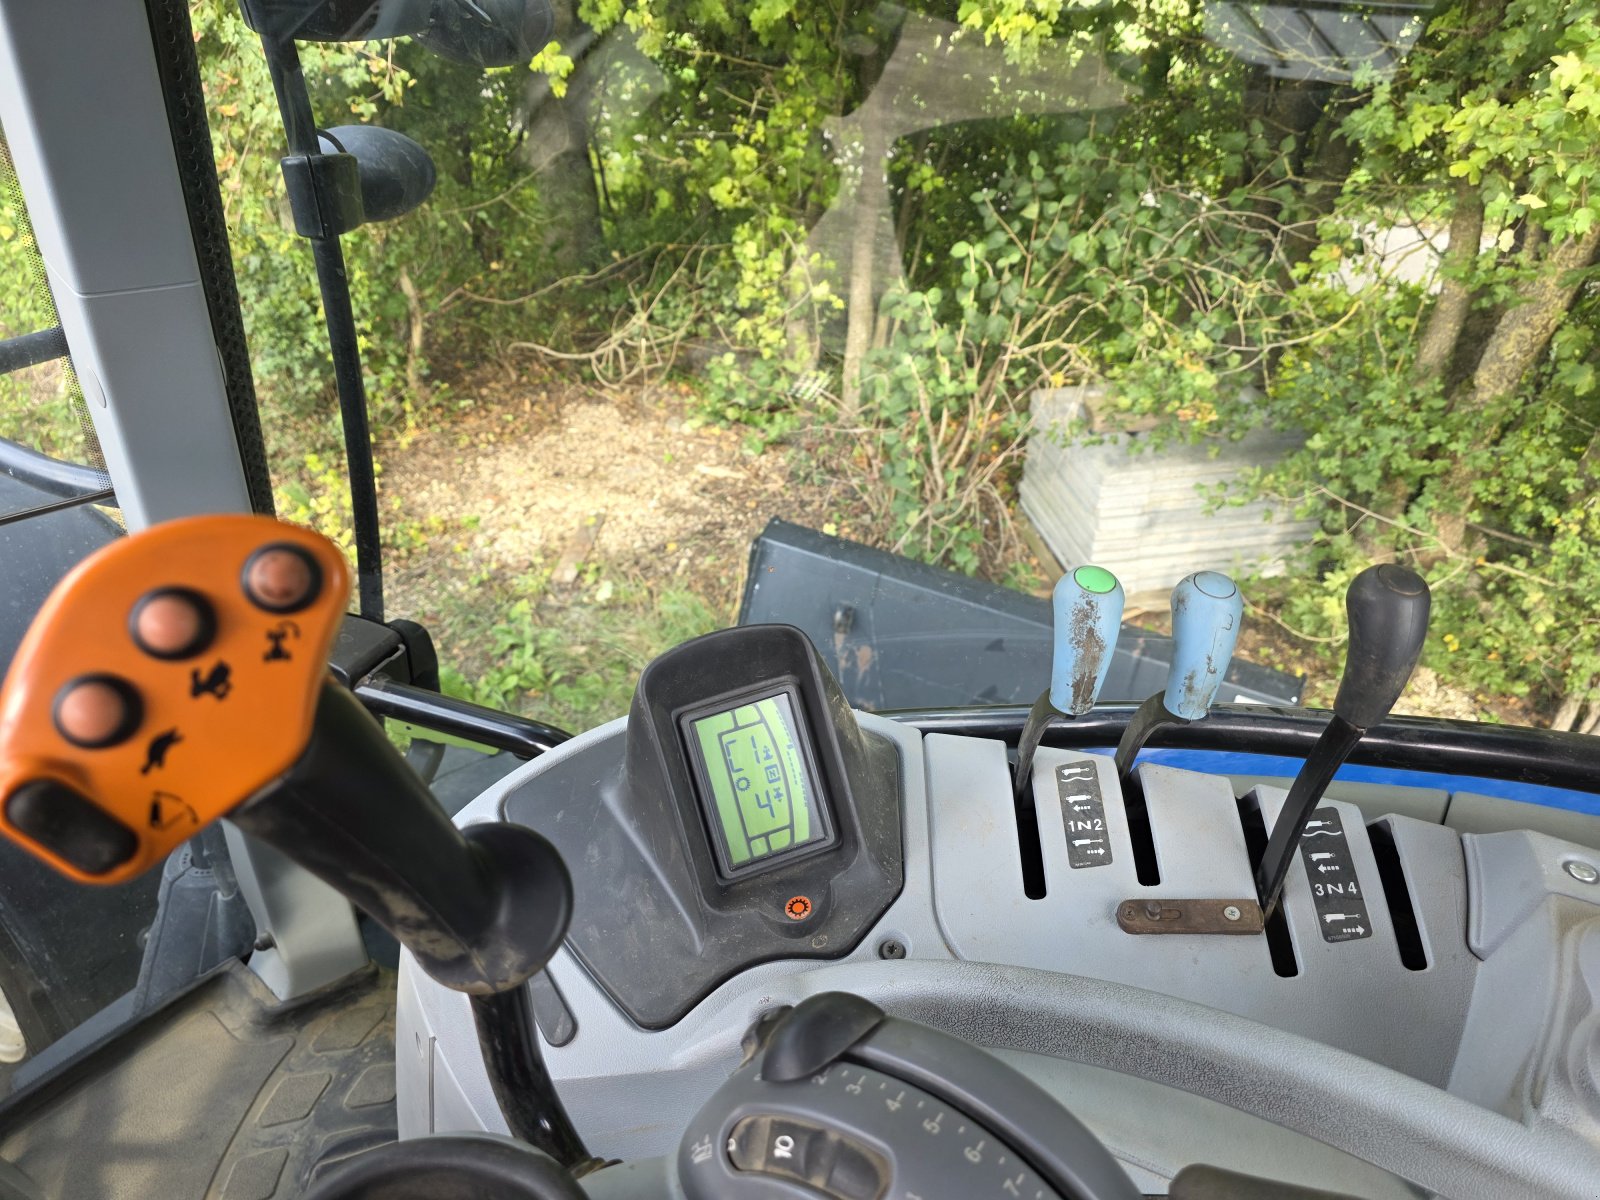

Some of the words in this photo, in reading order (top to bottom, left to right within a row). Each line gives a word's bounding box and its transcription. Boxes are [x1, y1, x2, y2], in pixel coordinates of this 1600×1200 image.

[754, 790, 776, 819] 4
[1314, 883, 1325, 897] 3
[1326, 883, 1344, 895] N
[1348, 881, 1358, 895] 4
[774, 1135, 795, 1159] 10
[845, 1083, 862, 1095] 3
[885, 1098, 902, 1112] 4
[922, 1118, 940, 1135] 5
[963, 1146, 982, 1164] 6
[1002, 1178, 1020, 1198] 7
